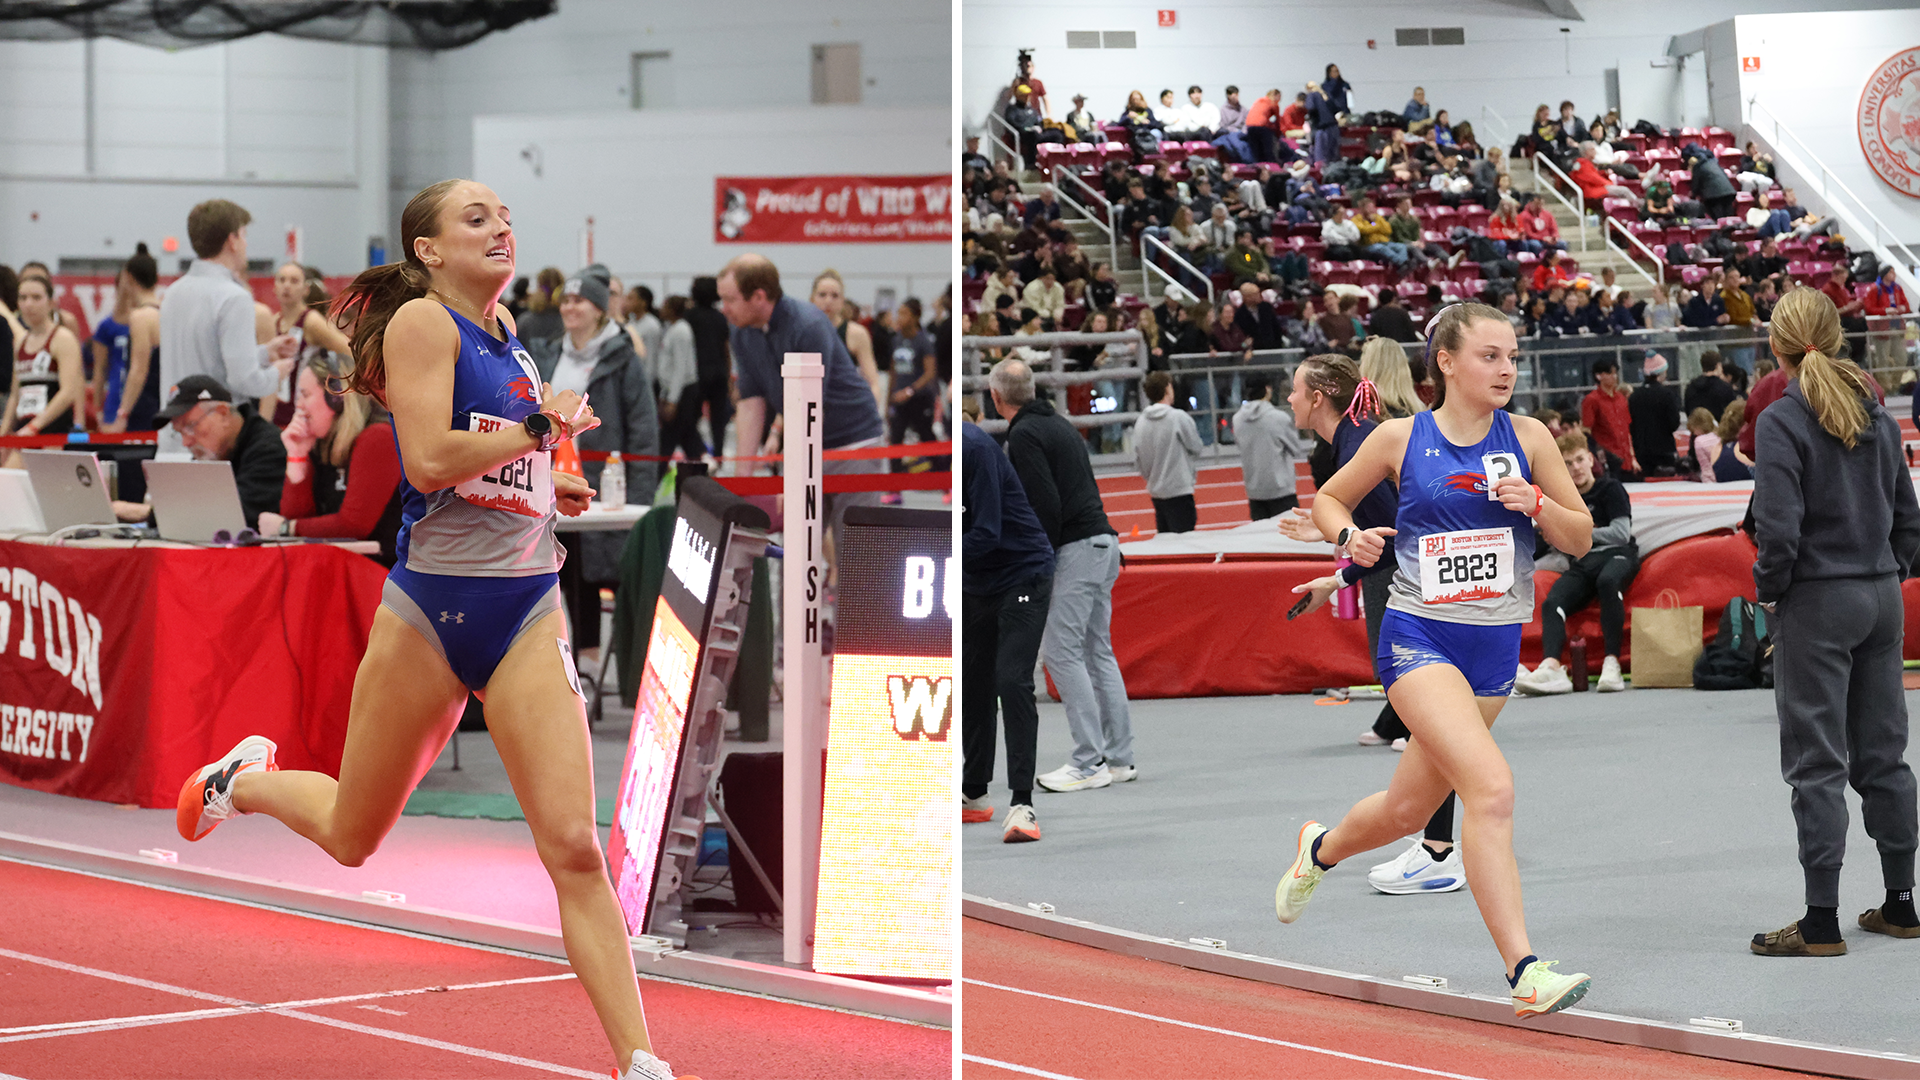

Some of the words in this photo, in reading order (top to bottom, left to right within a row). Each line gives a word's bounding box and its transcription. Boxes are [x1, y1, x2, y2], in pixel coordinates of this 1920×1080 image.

[1864, 55, 1916, 127] UNIVERSITAS
[1868, 139, 1911, 190] CONDITA
[756, 187, 822, 213] Proud
[825, 186, 850, 217] of
[856, 186, 915, 215] WHO
[804, 402, 818, 643] FINISH
[1425, 536, 1446, 553] BU
[1451, 536, 1472, 544] BOSTON
[1473, 533, 1505, 542] UNIVERSITY
[903, 556, 952, 619] B
[1438, 552, 1497, 584] 2823
[0, 703, 94, 763] ERSITY
